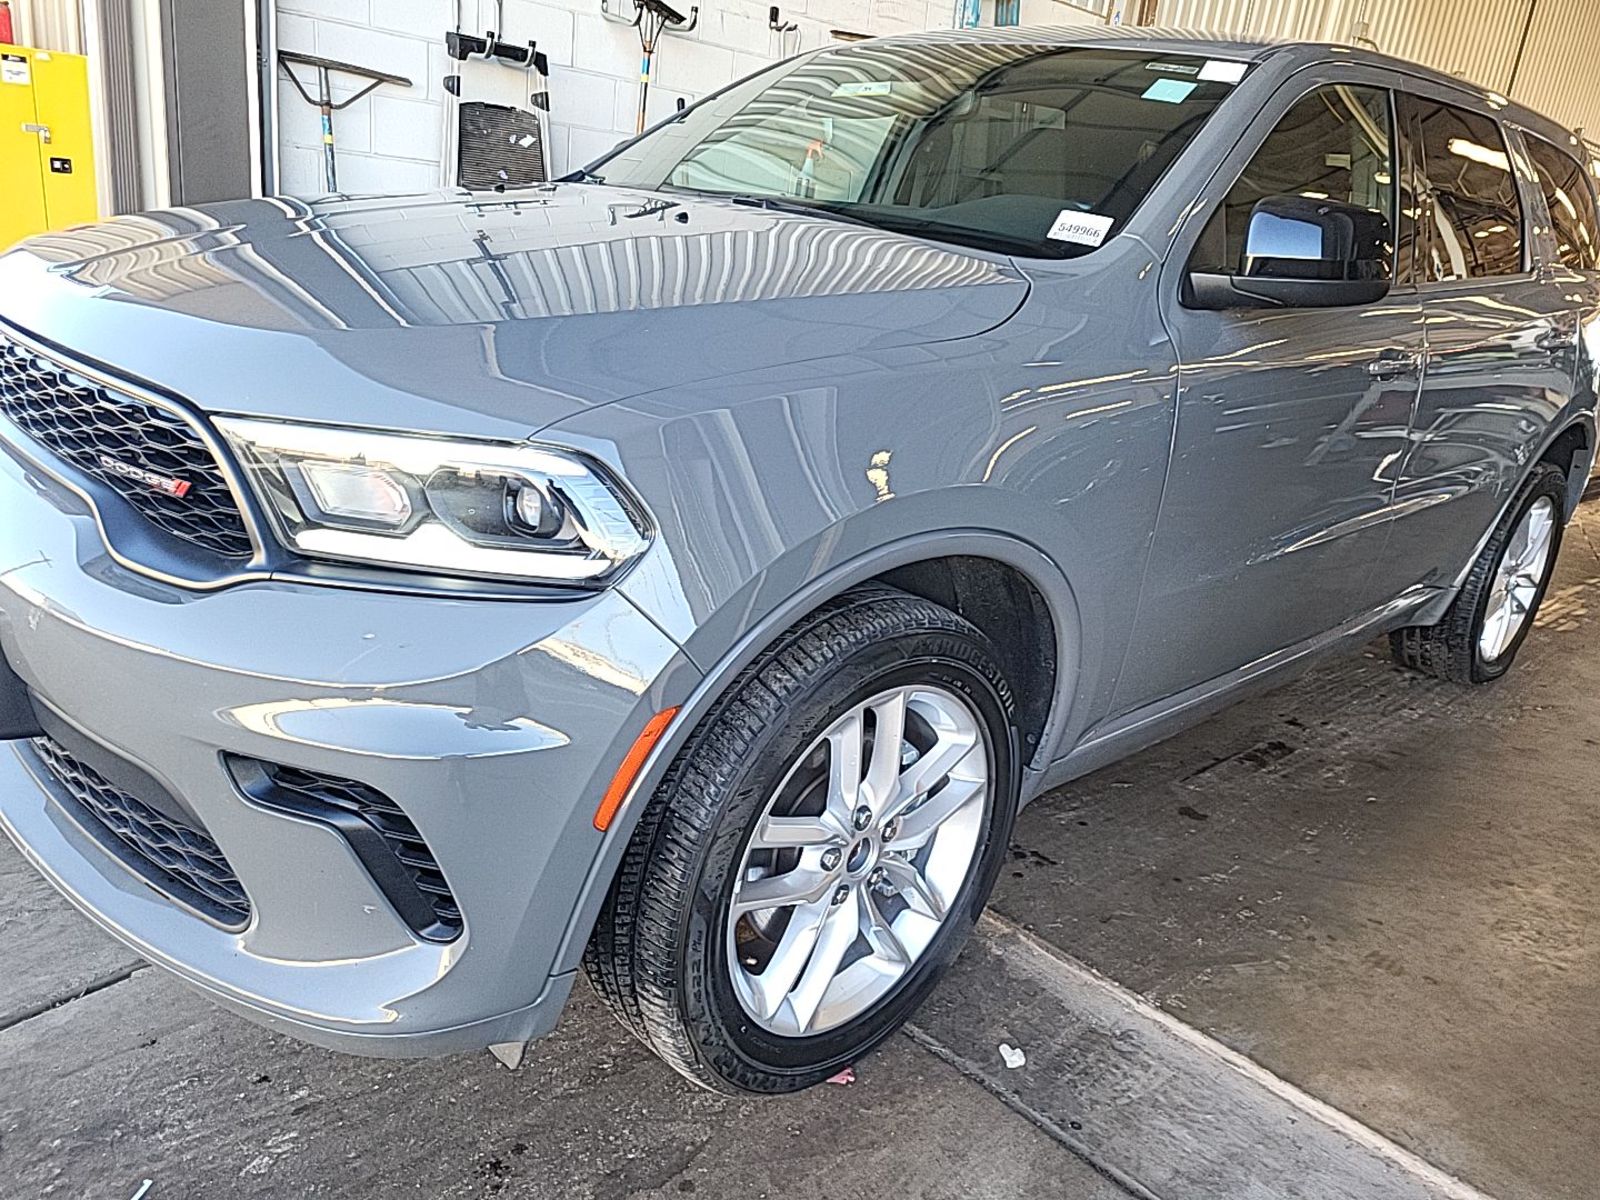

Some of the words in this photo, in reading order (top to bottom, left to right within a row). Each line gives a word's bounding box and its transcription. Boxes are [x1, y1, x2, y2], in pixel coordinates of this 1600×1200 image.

[1058, 222, 1101, 238] 549966
[100, 456, 177, 493] DODGE
[924, 637, 1016, 719] BRIDGESTONE
